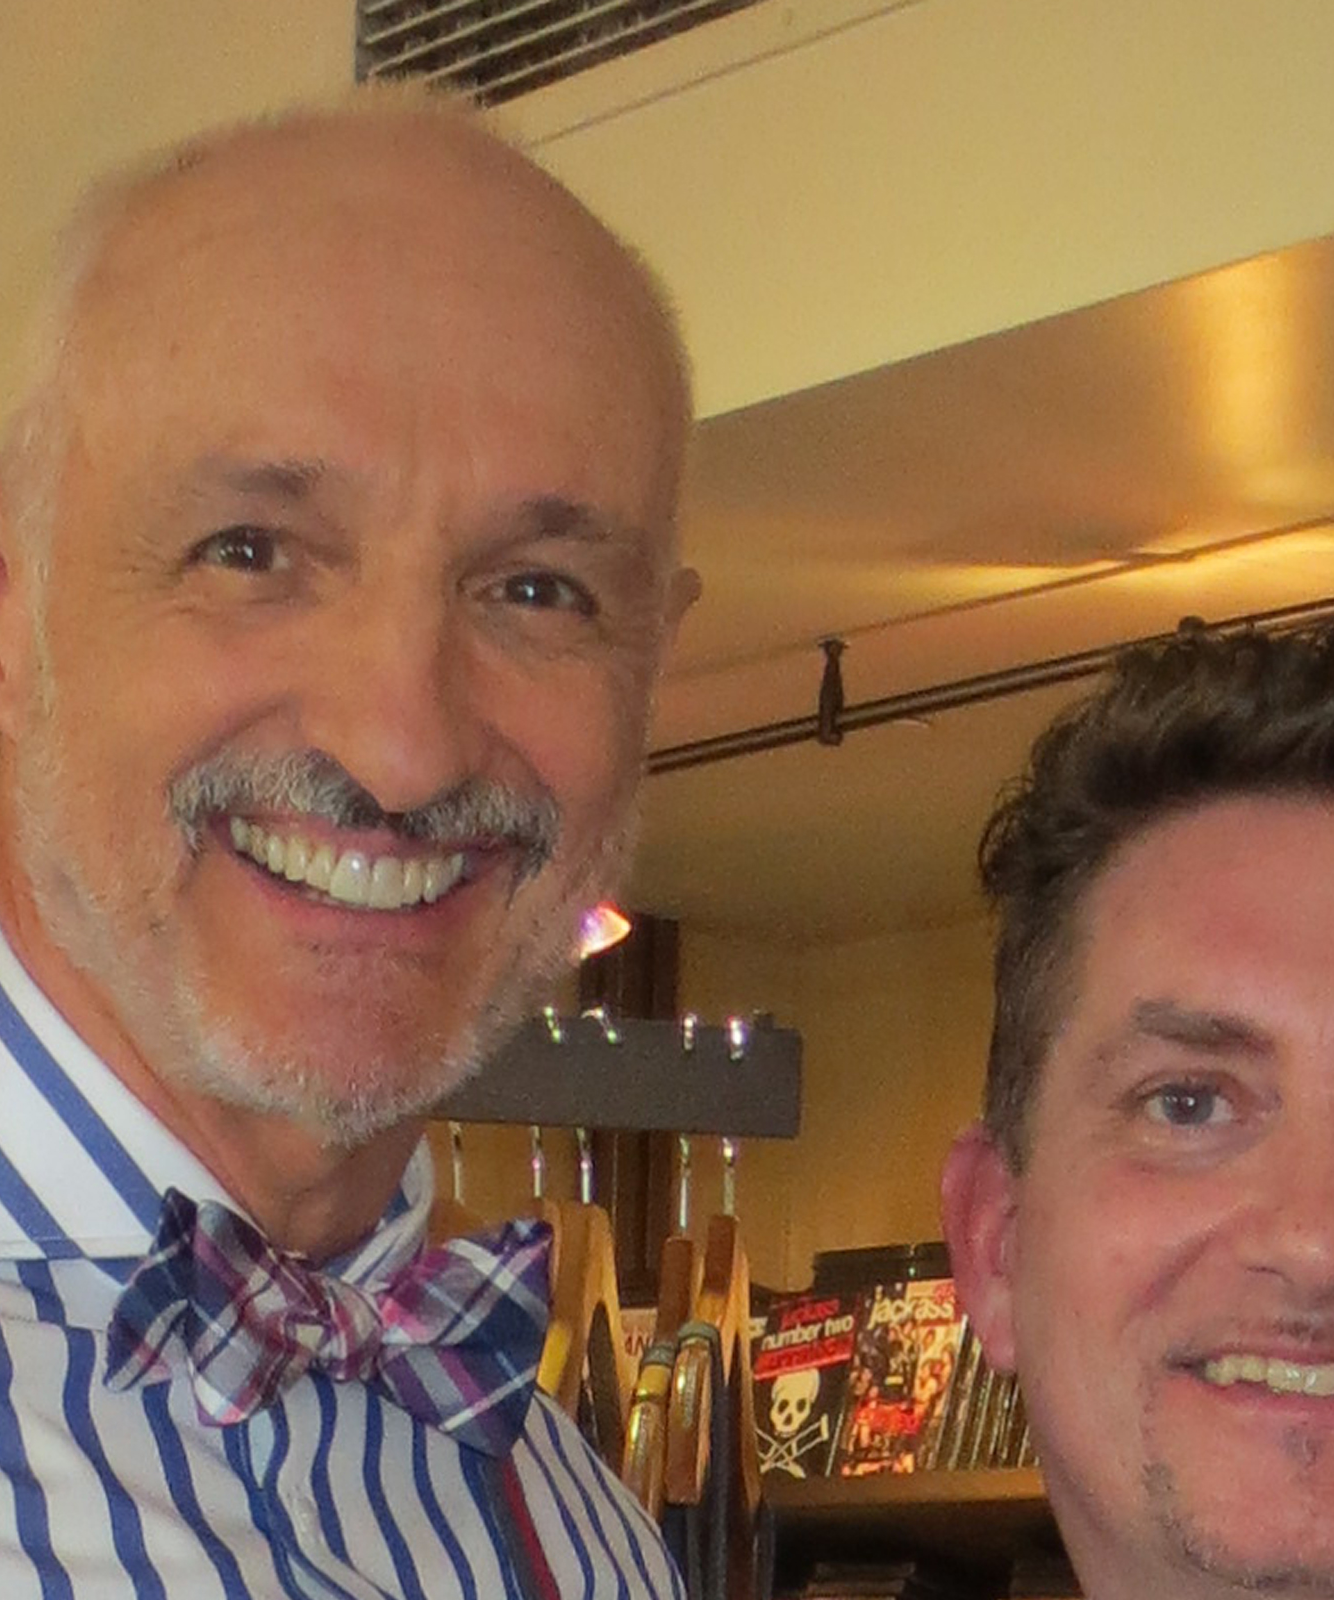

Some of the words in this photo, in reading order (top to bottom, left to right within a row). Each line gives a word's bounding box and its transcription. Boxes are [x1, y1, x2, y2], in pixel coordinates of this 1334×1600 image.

[867, 1285, 955, 1331] jackass
[761, 1322, 823, 1351] number
[824, 1315, 855, 1337] two
